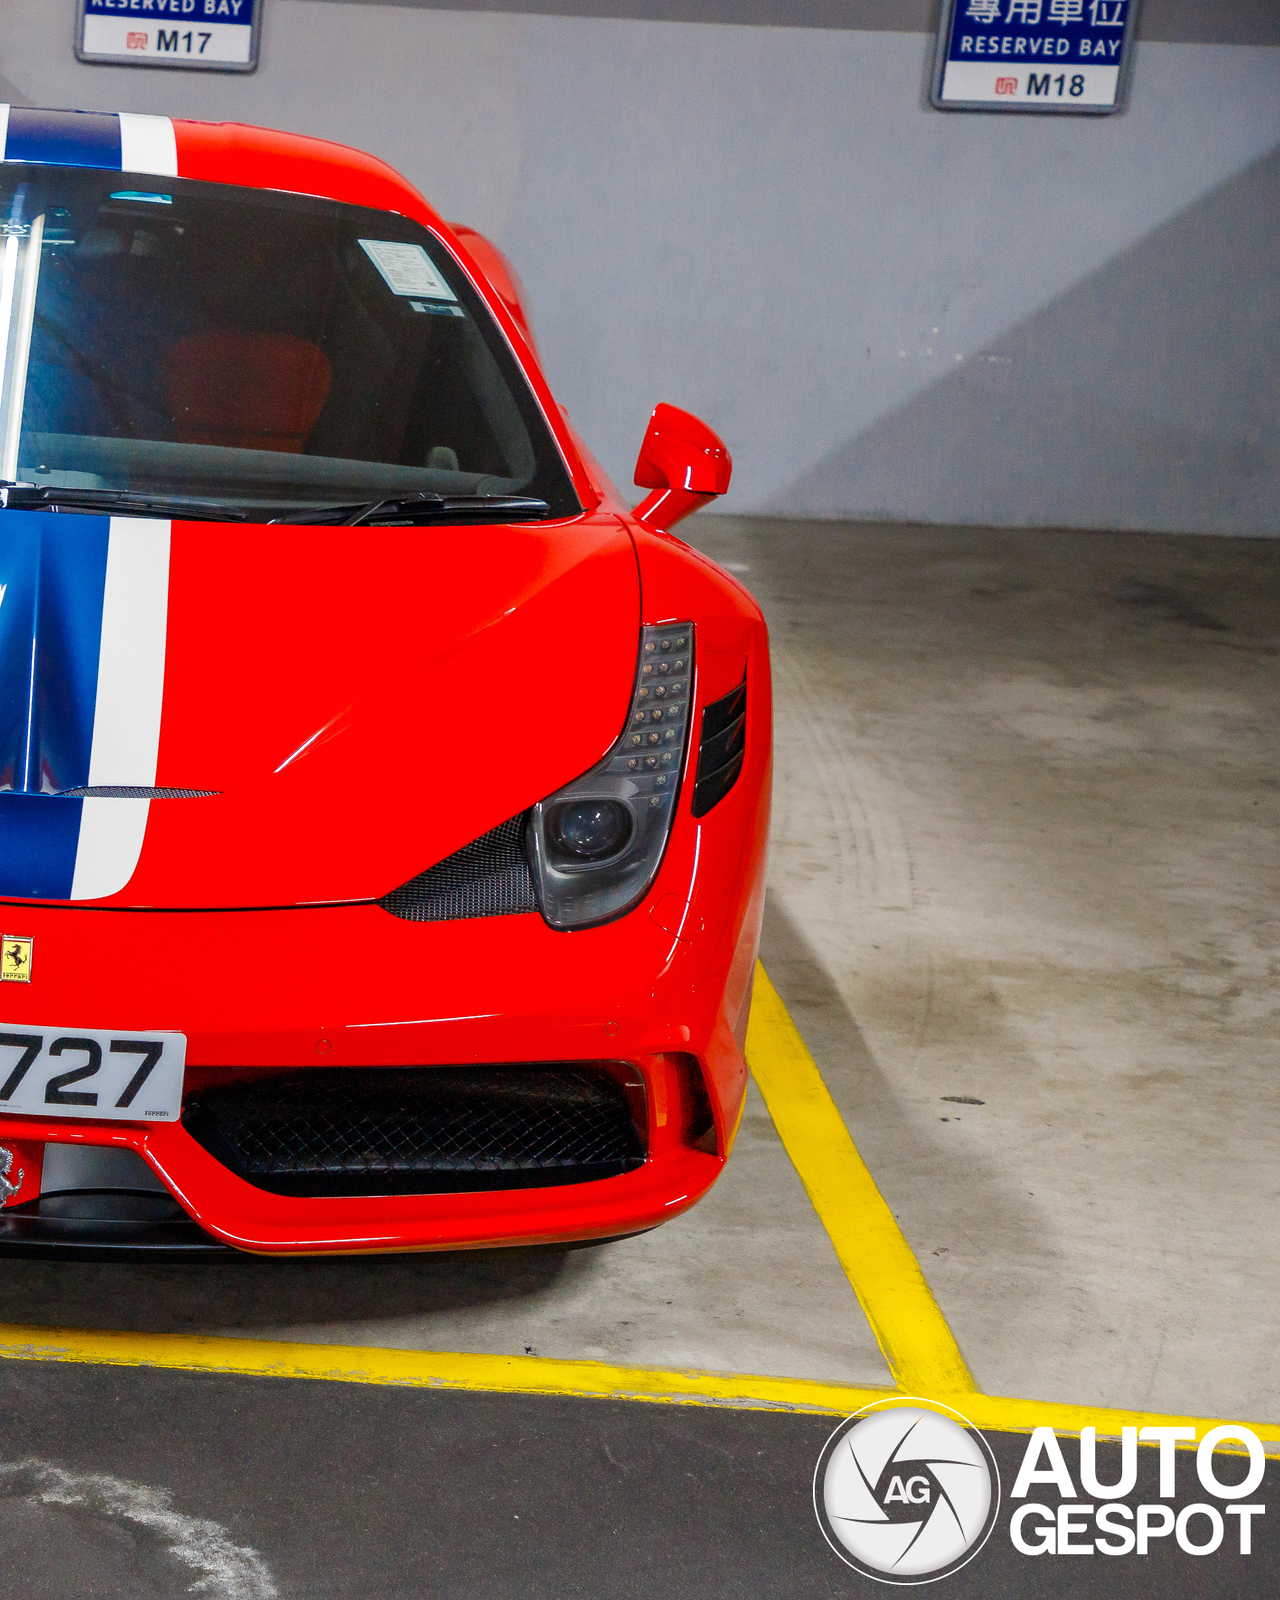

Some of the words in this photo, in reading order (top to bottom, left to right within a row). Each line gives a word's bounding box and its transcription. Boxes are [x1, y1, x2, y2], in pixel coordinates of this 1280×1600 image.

[204, 0, 243, 16] BAY
[965, 0, 1124, 26] 專用單位
[157, 29, 212, 53] M17
[960, 36, 1070, 55] RESERVED
[1078, 39, 1120, 57] BAY
[1026, 73, 1085, 97] M18
